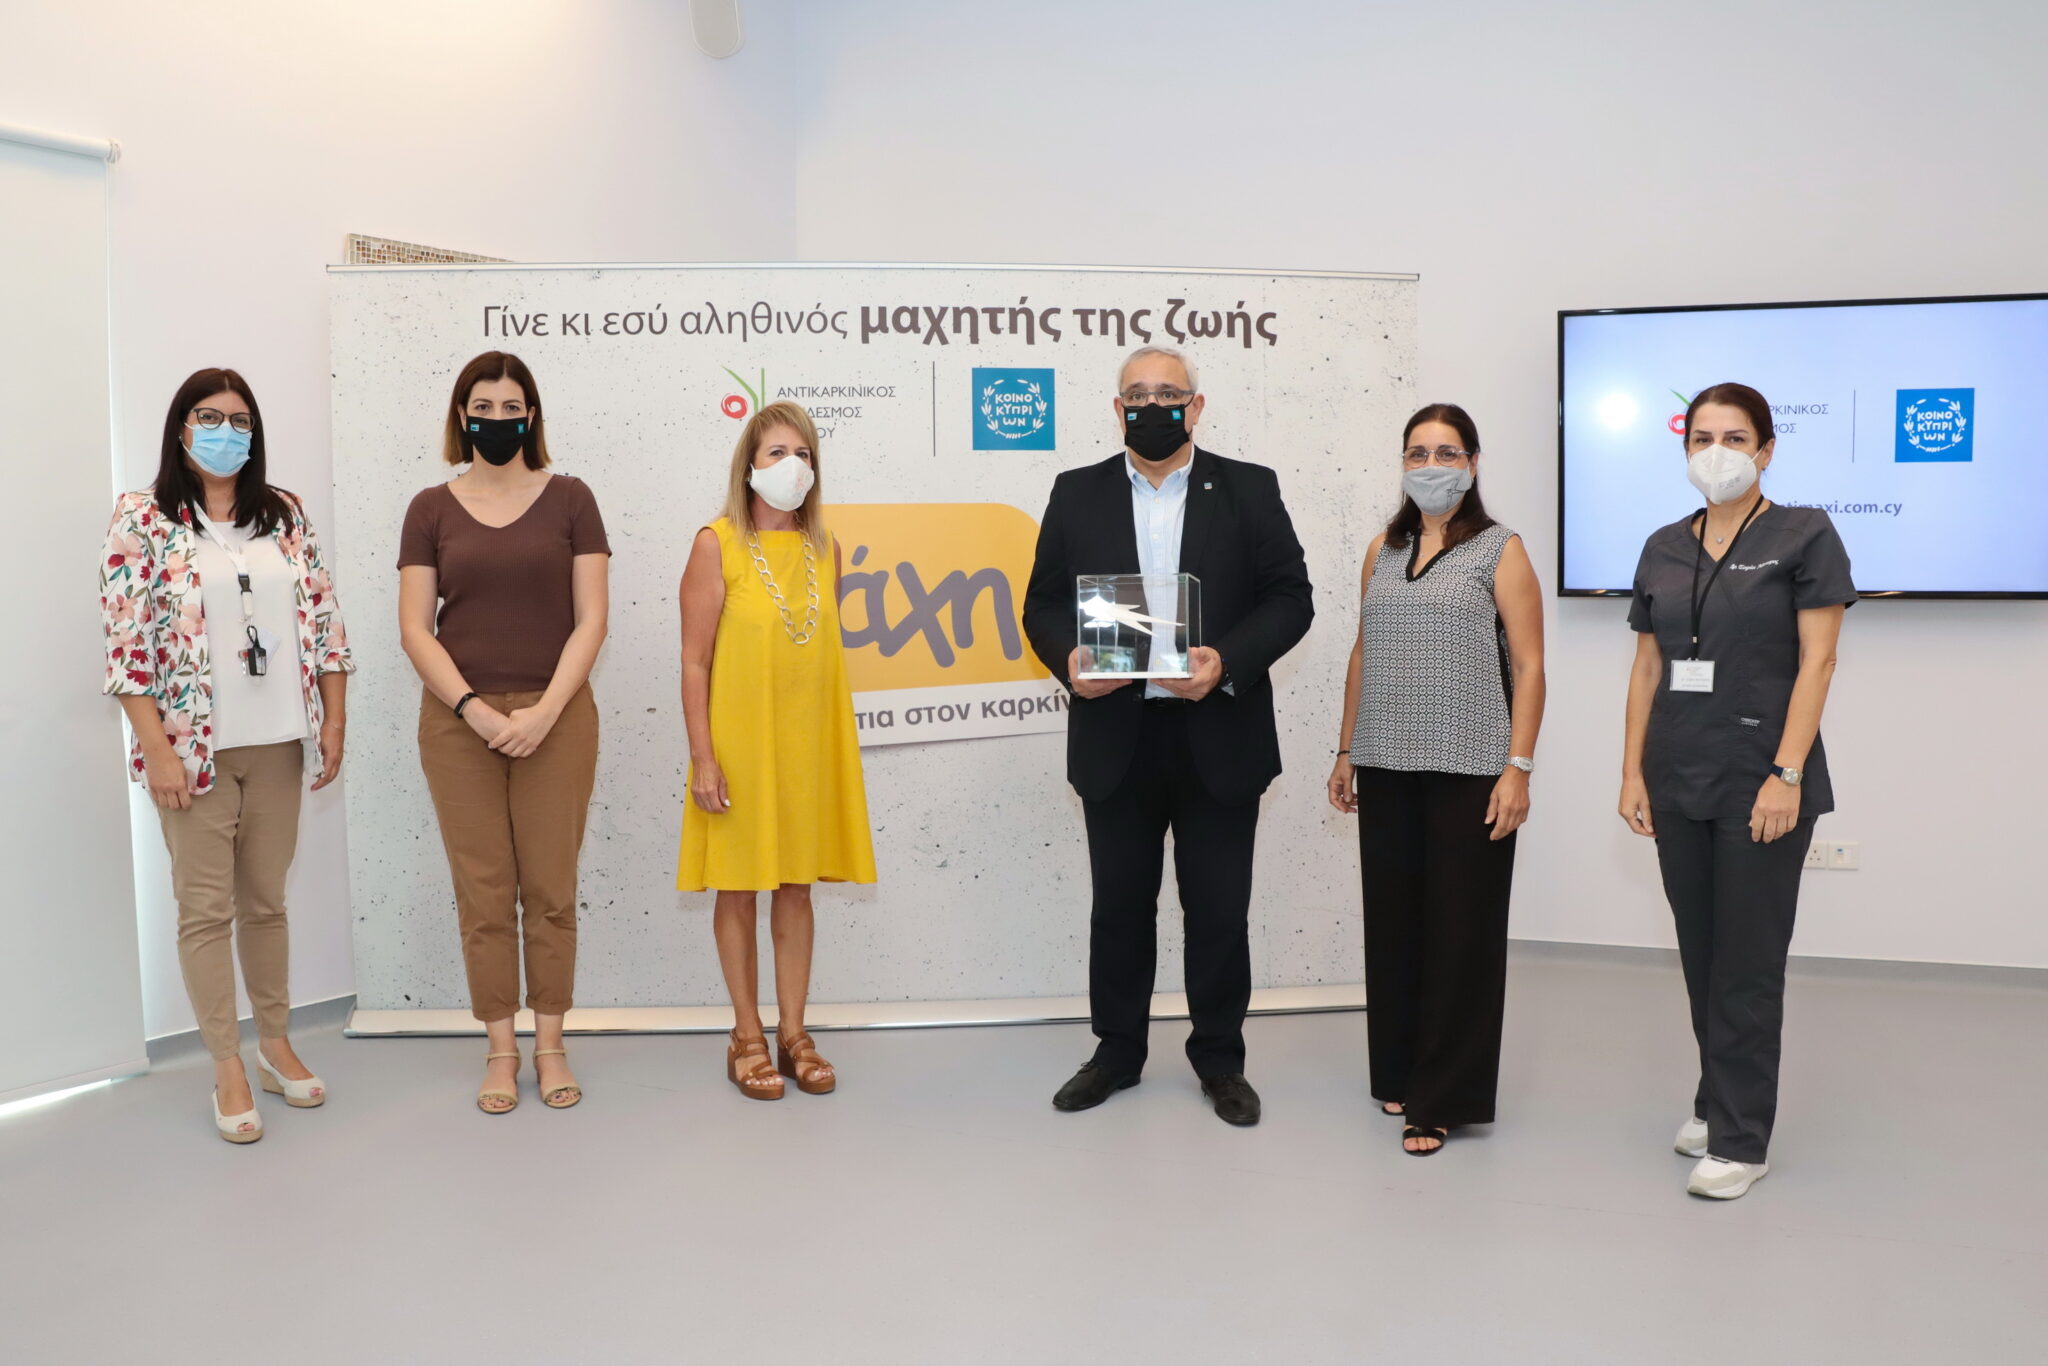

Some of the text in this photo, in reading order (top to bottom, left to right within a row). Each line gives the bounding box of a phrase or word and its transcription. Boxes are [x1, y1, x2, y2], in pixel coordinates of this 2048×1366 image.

[483, 296, 1278, 349] Γίνε κι εσύ αληθινός μαχητής της ζωής
[776, 385, 896, 398] ΑΝΤΙΚΑΡΚΙΝΙΚΟΣ
[807, 406, 863, 418] ΔΕΣΜΟΣ
[1769, 404, 1829, 416] ΡΚΙΝΙΚΟΣ
[840, 545, 1023, 669] άχη
[854, 688, 1070, 730] τια στον καρκίν
